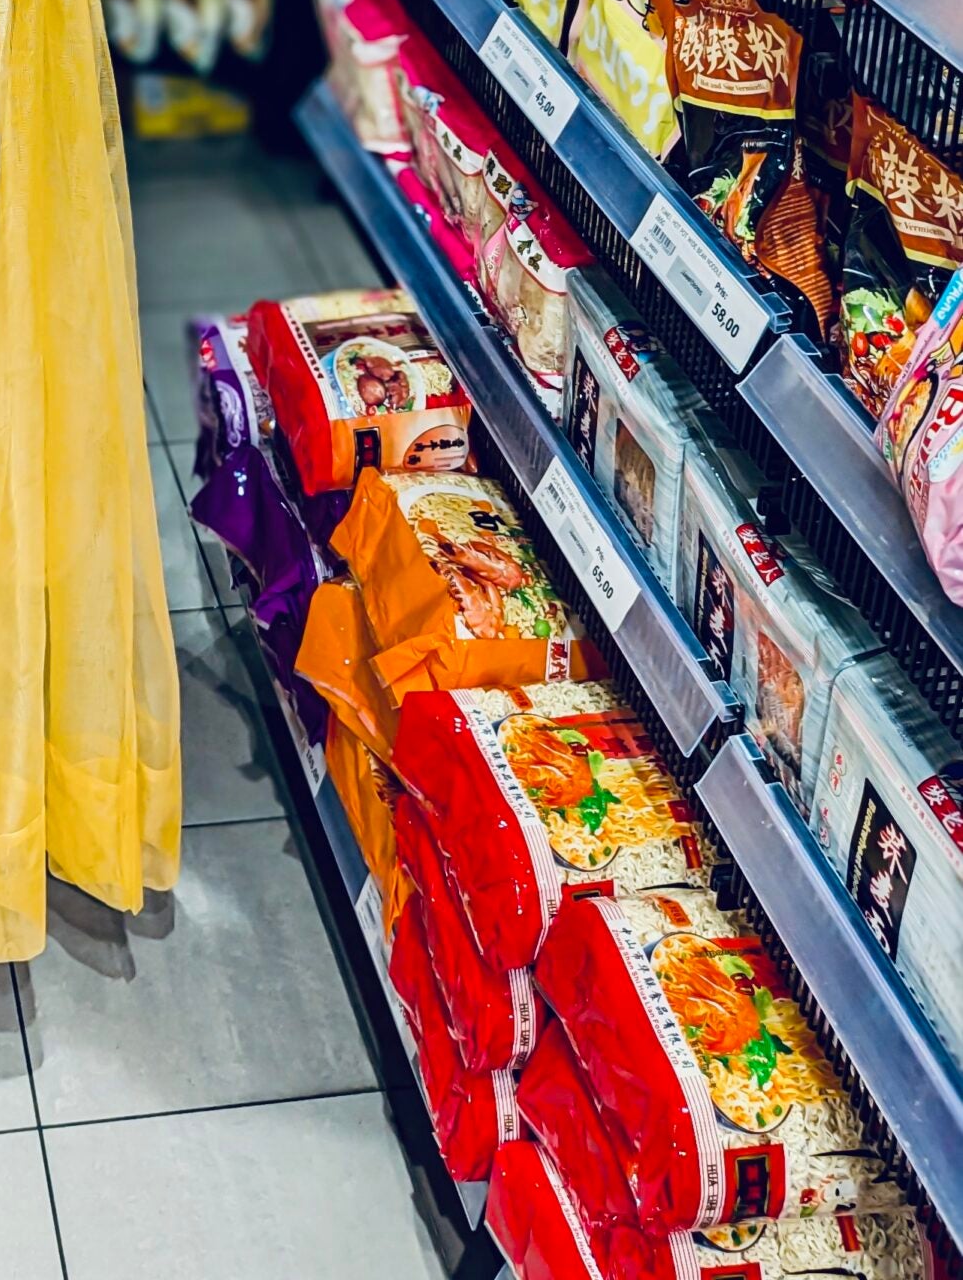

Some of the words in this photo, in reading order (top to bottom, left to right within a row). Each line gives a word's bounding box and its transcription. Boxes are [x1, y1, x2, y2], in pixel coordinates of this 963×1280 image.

[679, 10, 789, 86] 酸辣粉
[533, 90, 557, 116] 45,00
[713, 281, 730, 298] Pris:
[709, 302, 743, 337] 58,00
[589, 564, 617, 598] 65,00
[707, 1164, 718, 1187] HUA
